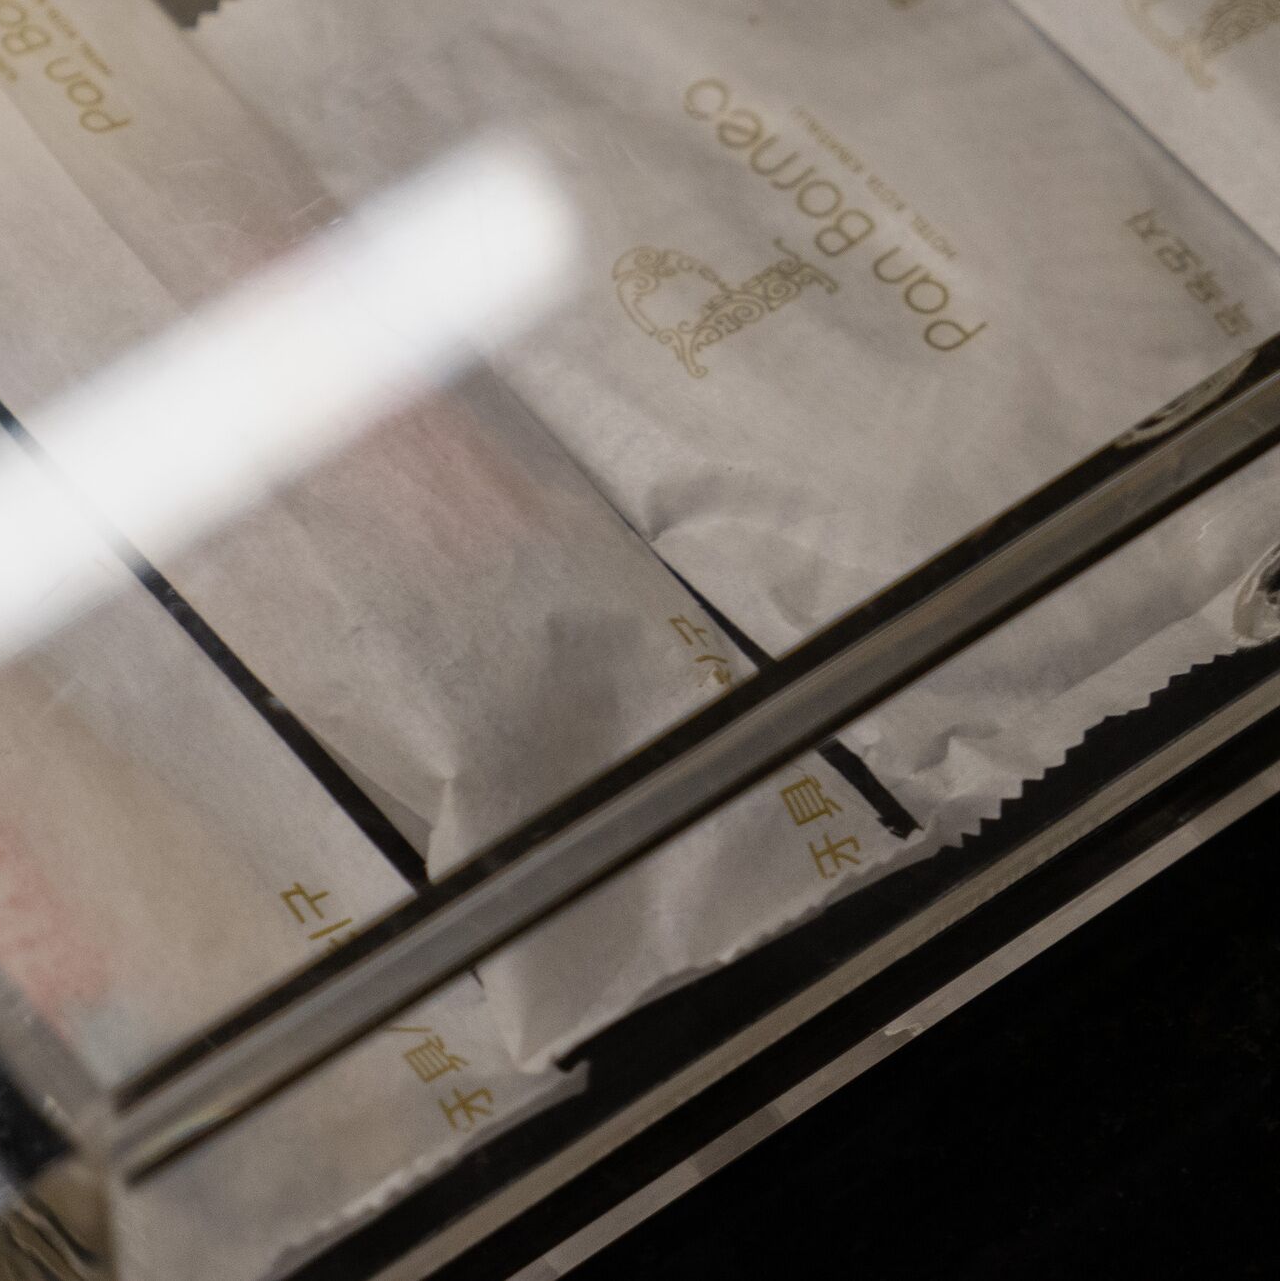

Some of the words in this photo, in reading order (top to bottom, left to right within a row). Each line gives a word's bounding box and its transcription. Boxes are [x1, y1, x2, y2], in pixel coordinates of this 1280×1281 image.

[43, 56, 132, 135] Pan
[682, 77, 876, 258] Borneo
[873, 244, 987, 352] Pan
